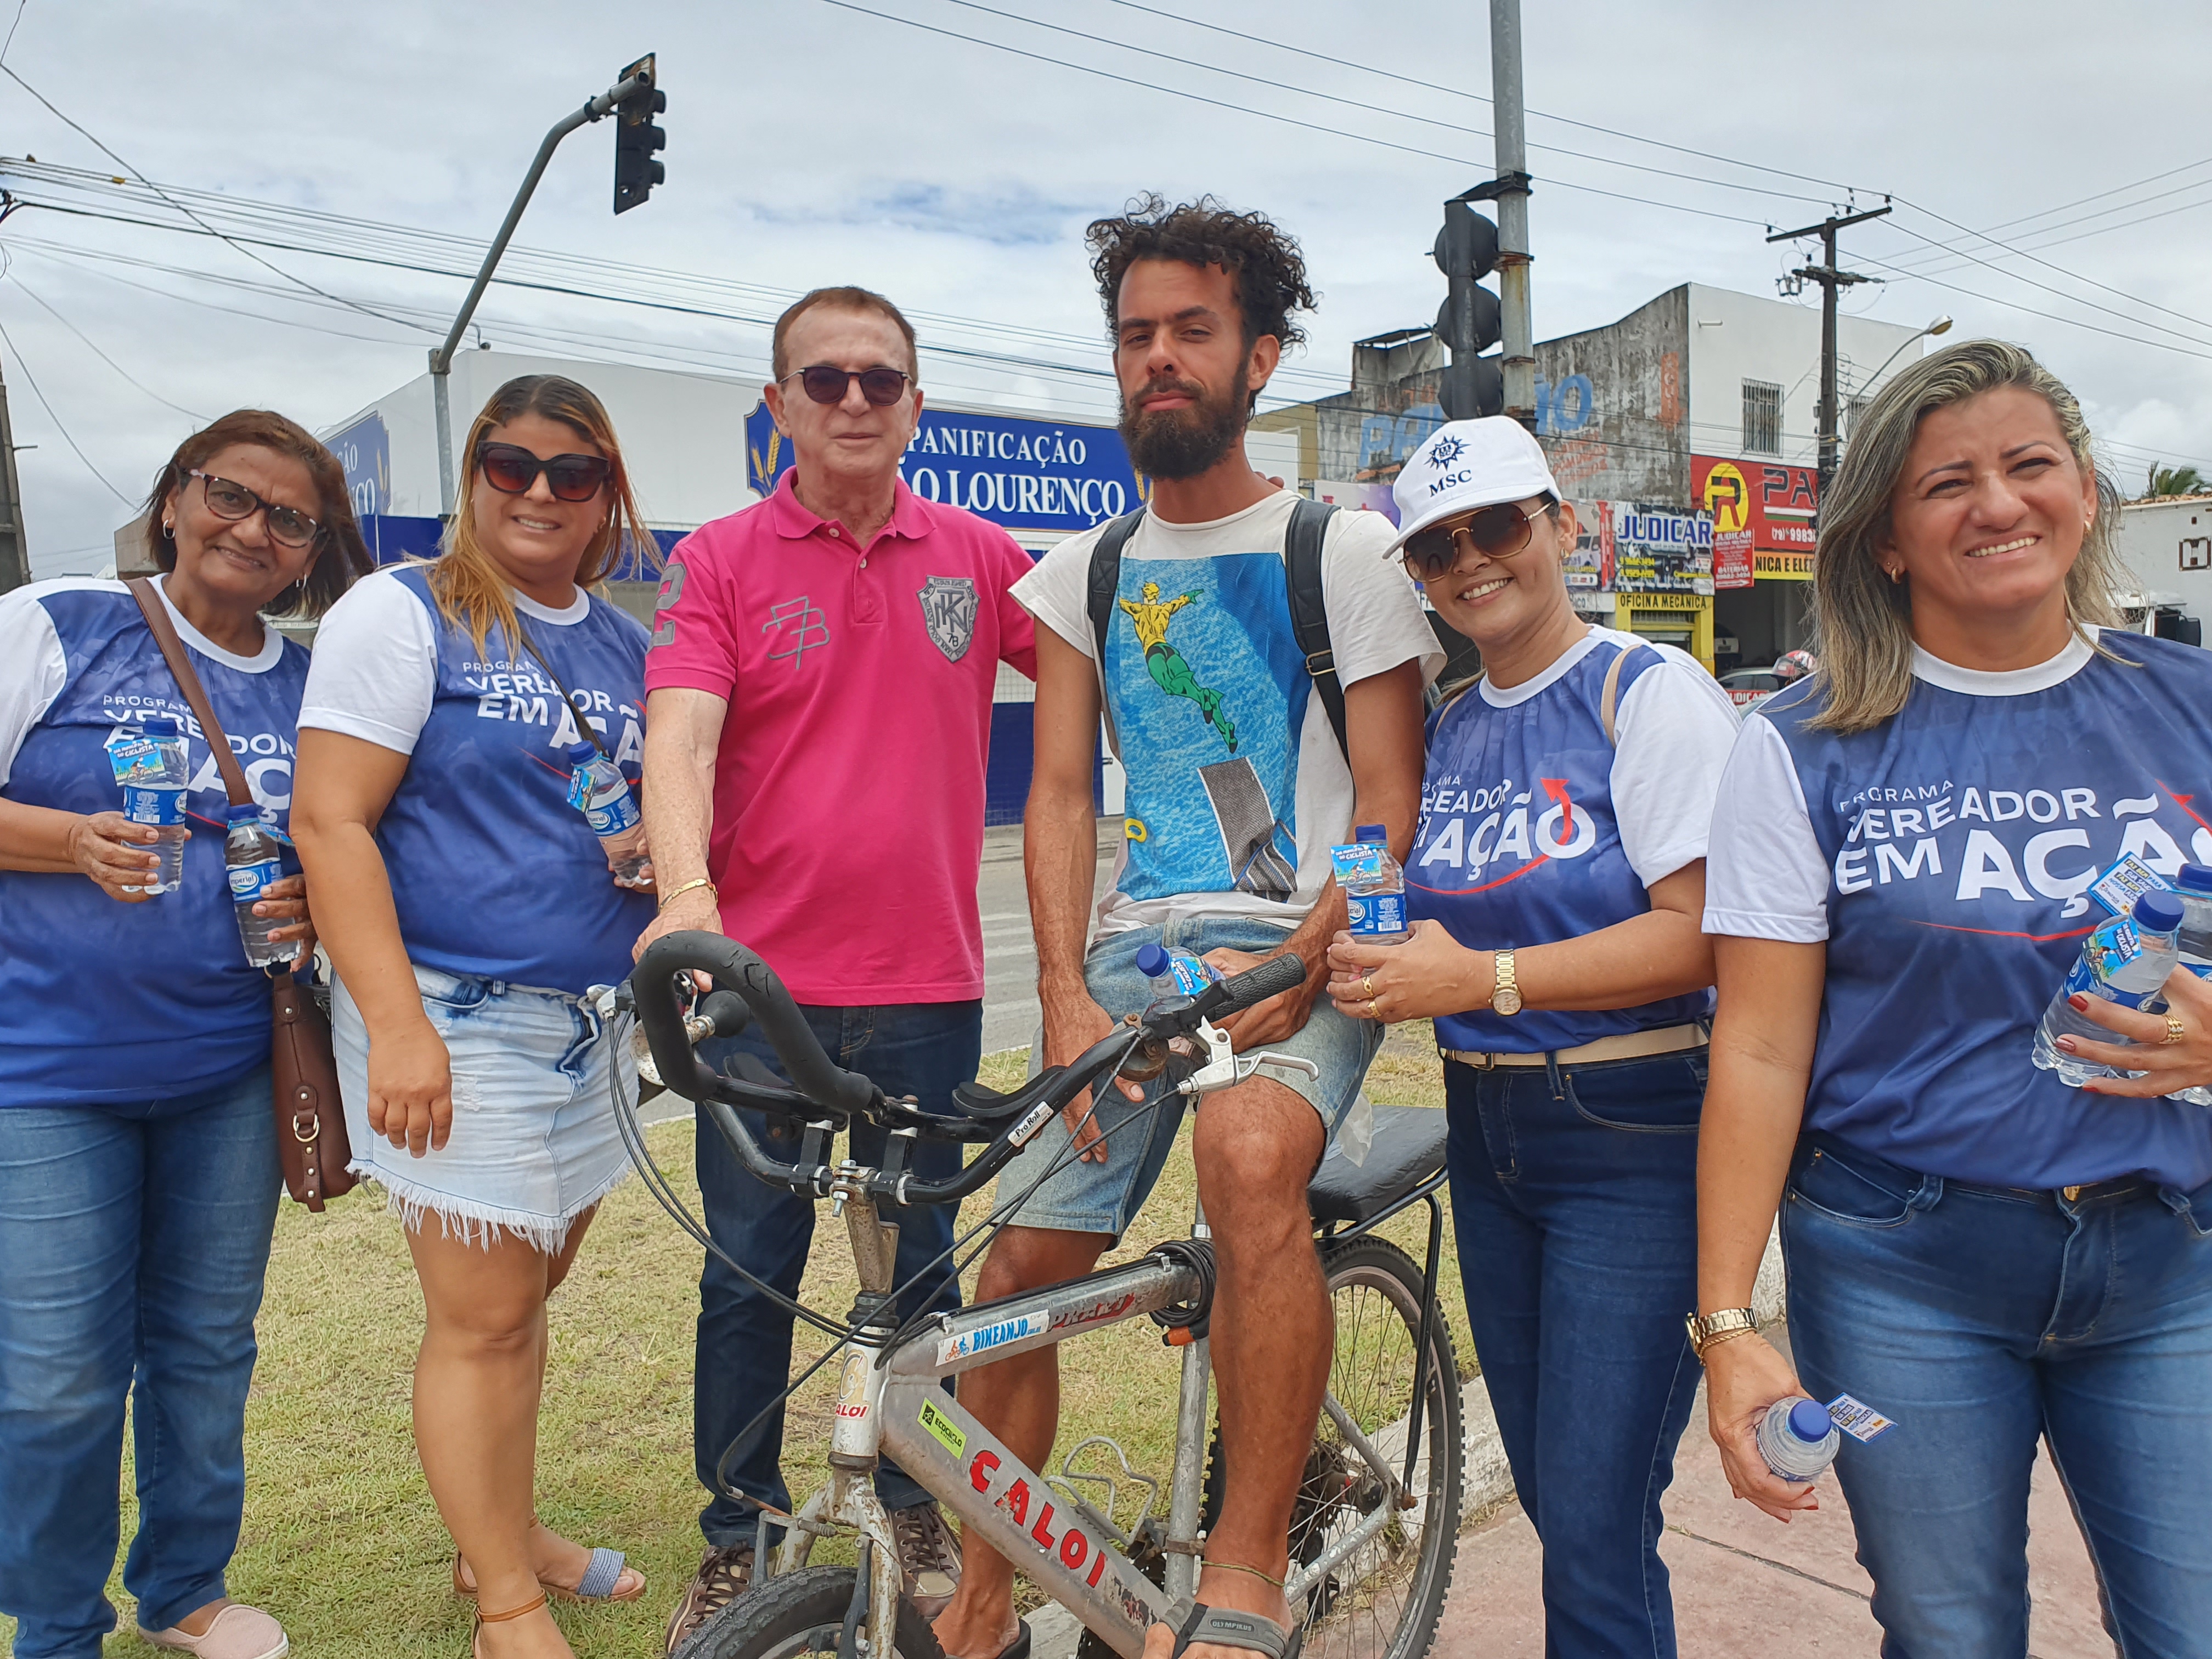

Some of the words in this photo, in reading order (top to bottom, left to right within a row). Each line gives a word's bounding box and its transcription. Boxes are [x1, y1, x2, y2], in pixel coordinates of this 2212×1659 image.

[906, 426, 1087, 469] PANIFICAÇÃO
[946, 470, 1126, 526] LOURENÇO
[1429, 470, 1472, 498] MSC
[1763, 466, 1817, 507] PA
[1618, 515, 1711, 545] JUDICAR
[1755, 556, 1781, 572] NICA
[1785, 557, 1790, 572] E
[1620, 594, 1659, 608] OFICINA
[946, 632, 959, 647] 78
[463, 660, 542, 675] PROGRAM
[103, 694, 193, 713] PROGRAM
[465, 673, 614, 713] VEREAOR
[477, 692, 549, 726] EM
[125, 744, 154, 757] CICLISTA
[1839, 779, 1955, 813] PROGRAMA
[1846, 786, 2102, 843] VEREADOR
[1419, 788, 1596, 881] AÇÃO
[1345, 850, 1373, 860] CICLISTA
[1835, 836, 1943, 895] EM
[1348, 906, 1361, 915] erial
[1026, 1110, 1041, 1126] Roll
[972, 1318, 1029, 1352] BIKEANJO
[836, 1403, 869, 1418] ALOI
[969, 1449, 1109, 1589] CALOI
[1212, 1620, 1252, 1632] OLYMPIKUS
